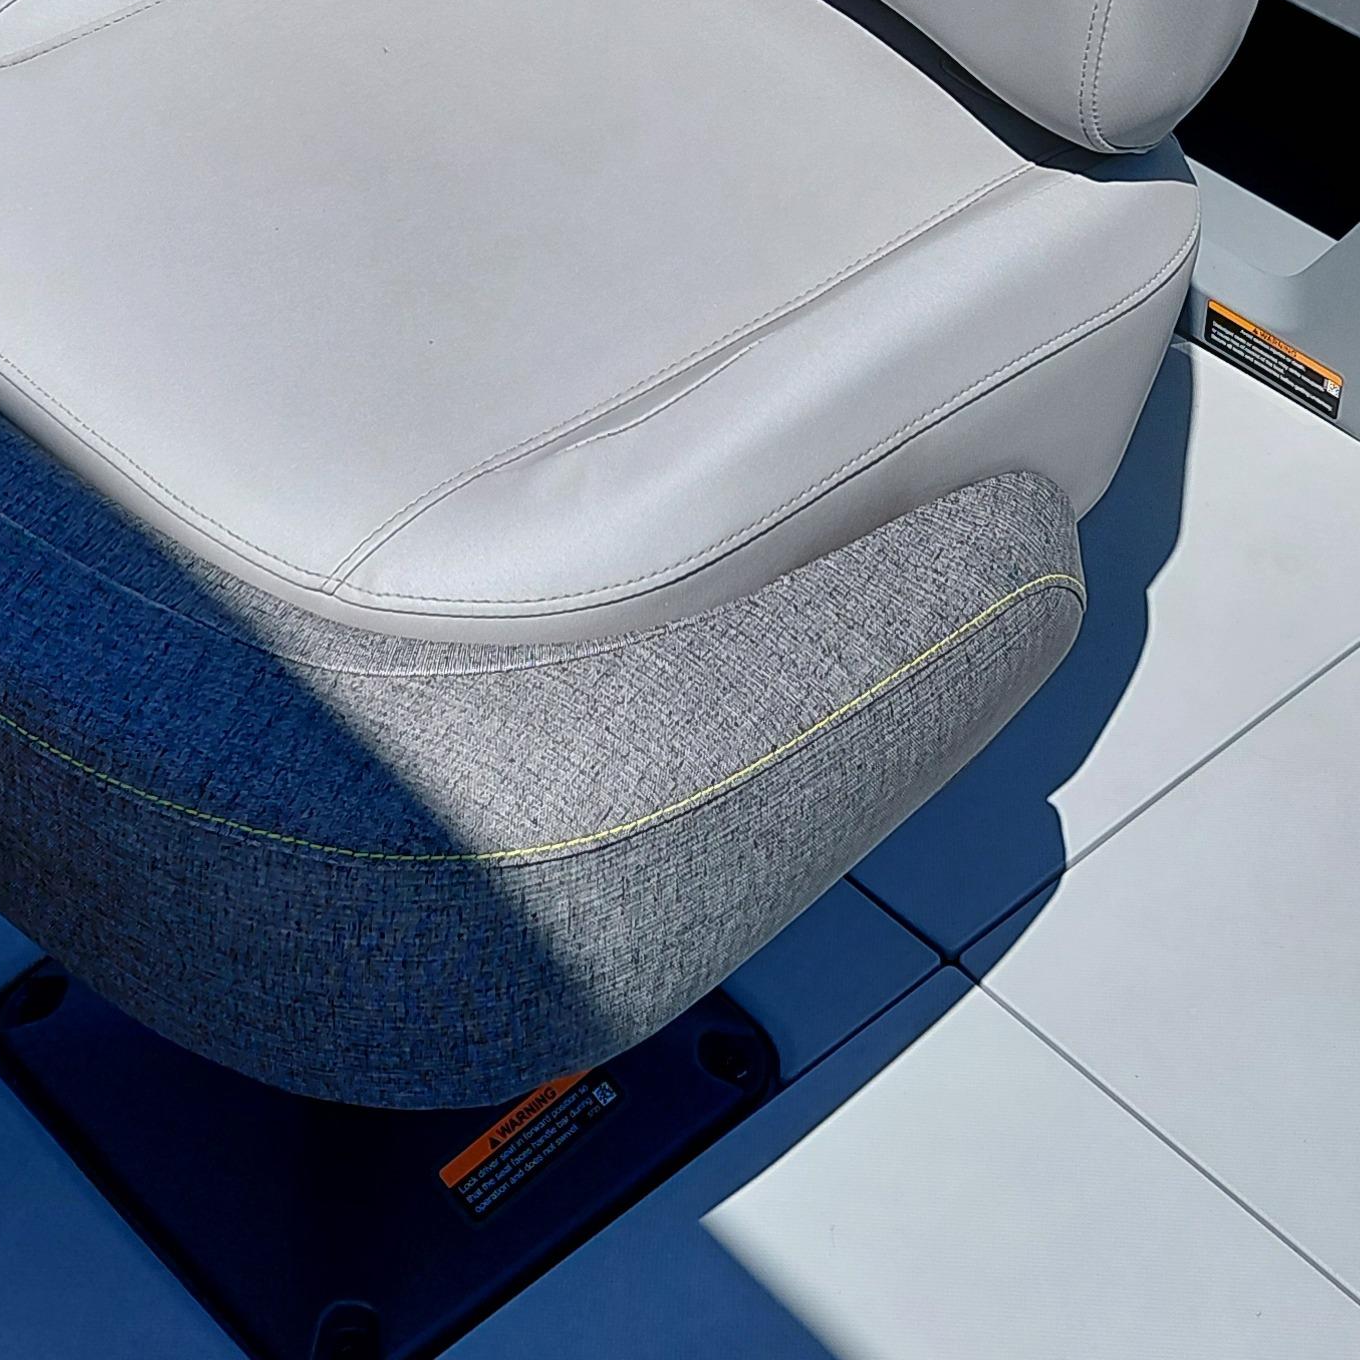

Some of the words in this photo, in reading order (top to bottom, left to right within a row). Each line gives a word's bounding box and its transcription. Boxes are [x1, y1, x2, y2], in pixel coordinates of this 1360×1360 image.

[458, 1175, 477, 1193] Lock
[476, 1157, 499, 1178] driver
[498, 1143, 516, 1160] seat
[522, 1114, 551, 1140] forward
[550, 1092, 579, 1117] position
[466, 1188, 482, 1203] that
[494, 1163, 512, 1180] seat
[510, 1146, 532, 1166] faces
[530, 1125, 556, 1148] handle
[568, 1095, 593, 1118] during
[495, 1085, 558, 1139] WARNING
[473, 1181, 510, 1214] operation
[508, 1169, 524, 1184] and
[523, 1153, 543, 1171] does
[541, 1142, 555, 1156] not
